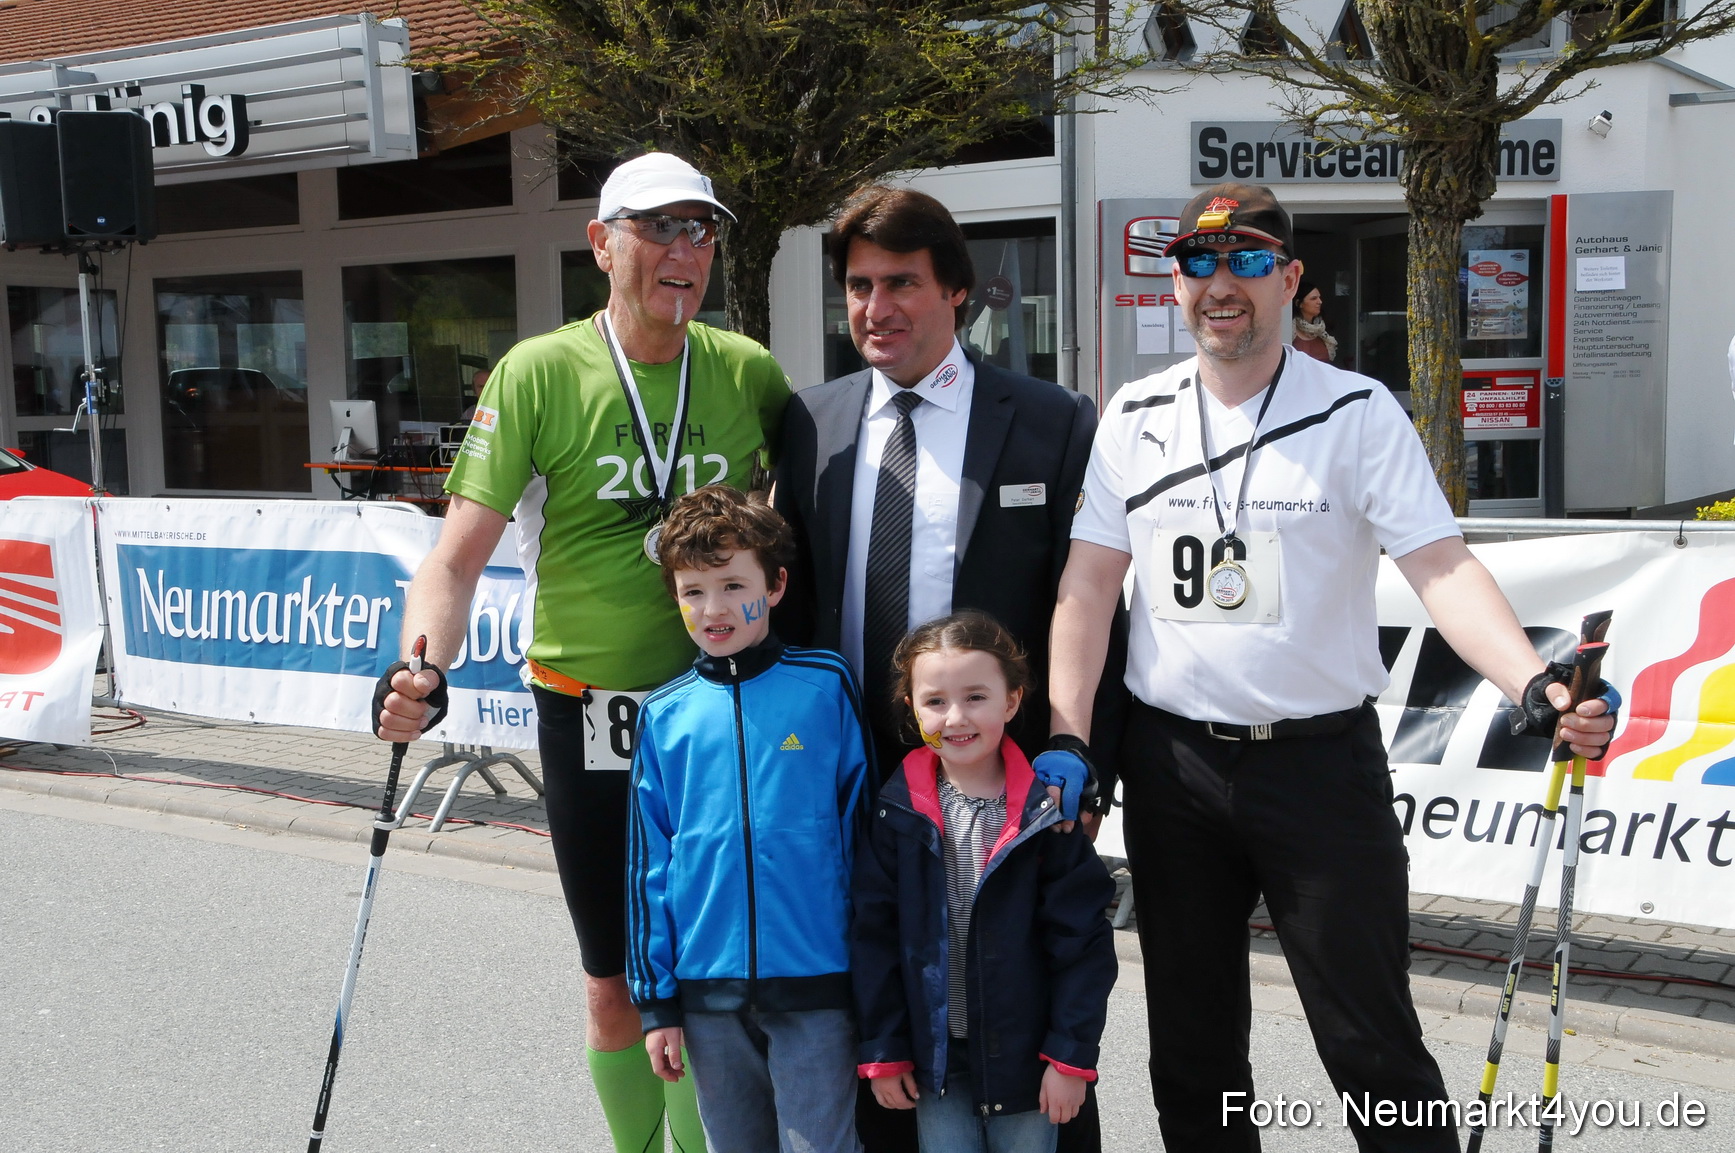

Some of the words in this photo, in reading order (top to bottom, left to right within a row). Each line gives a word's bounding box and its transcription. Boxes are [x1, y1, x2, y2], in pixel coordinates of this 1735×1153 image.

[1198, 126, 1555, 179] Serviceame
[1575, 236, 1629, 244] Autohaus
[1575, 246, 1619, 254] Gerhart
[1635, 244, 1663, 253] Jänig
[1115, 294, 1180, 306] SEA
[1573, 343, 1650, 351] Hauptuntersuchung
[614, 422, 706, 447] FURH
[596, 454, 729, 500] 2012
[114, 530, 207, 541] WWW.MITTELBAYERISCHE.DE
[136, 567, 392, 650] Neumarkter
[477, 697, 533, 728] Hier
